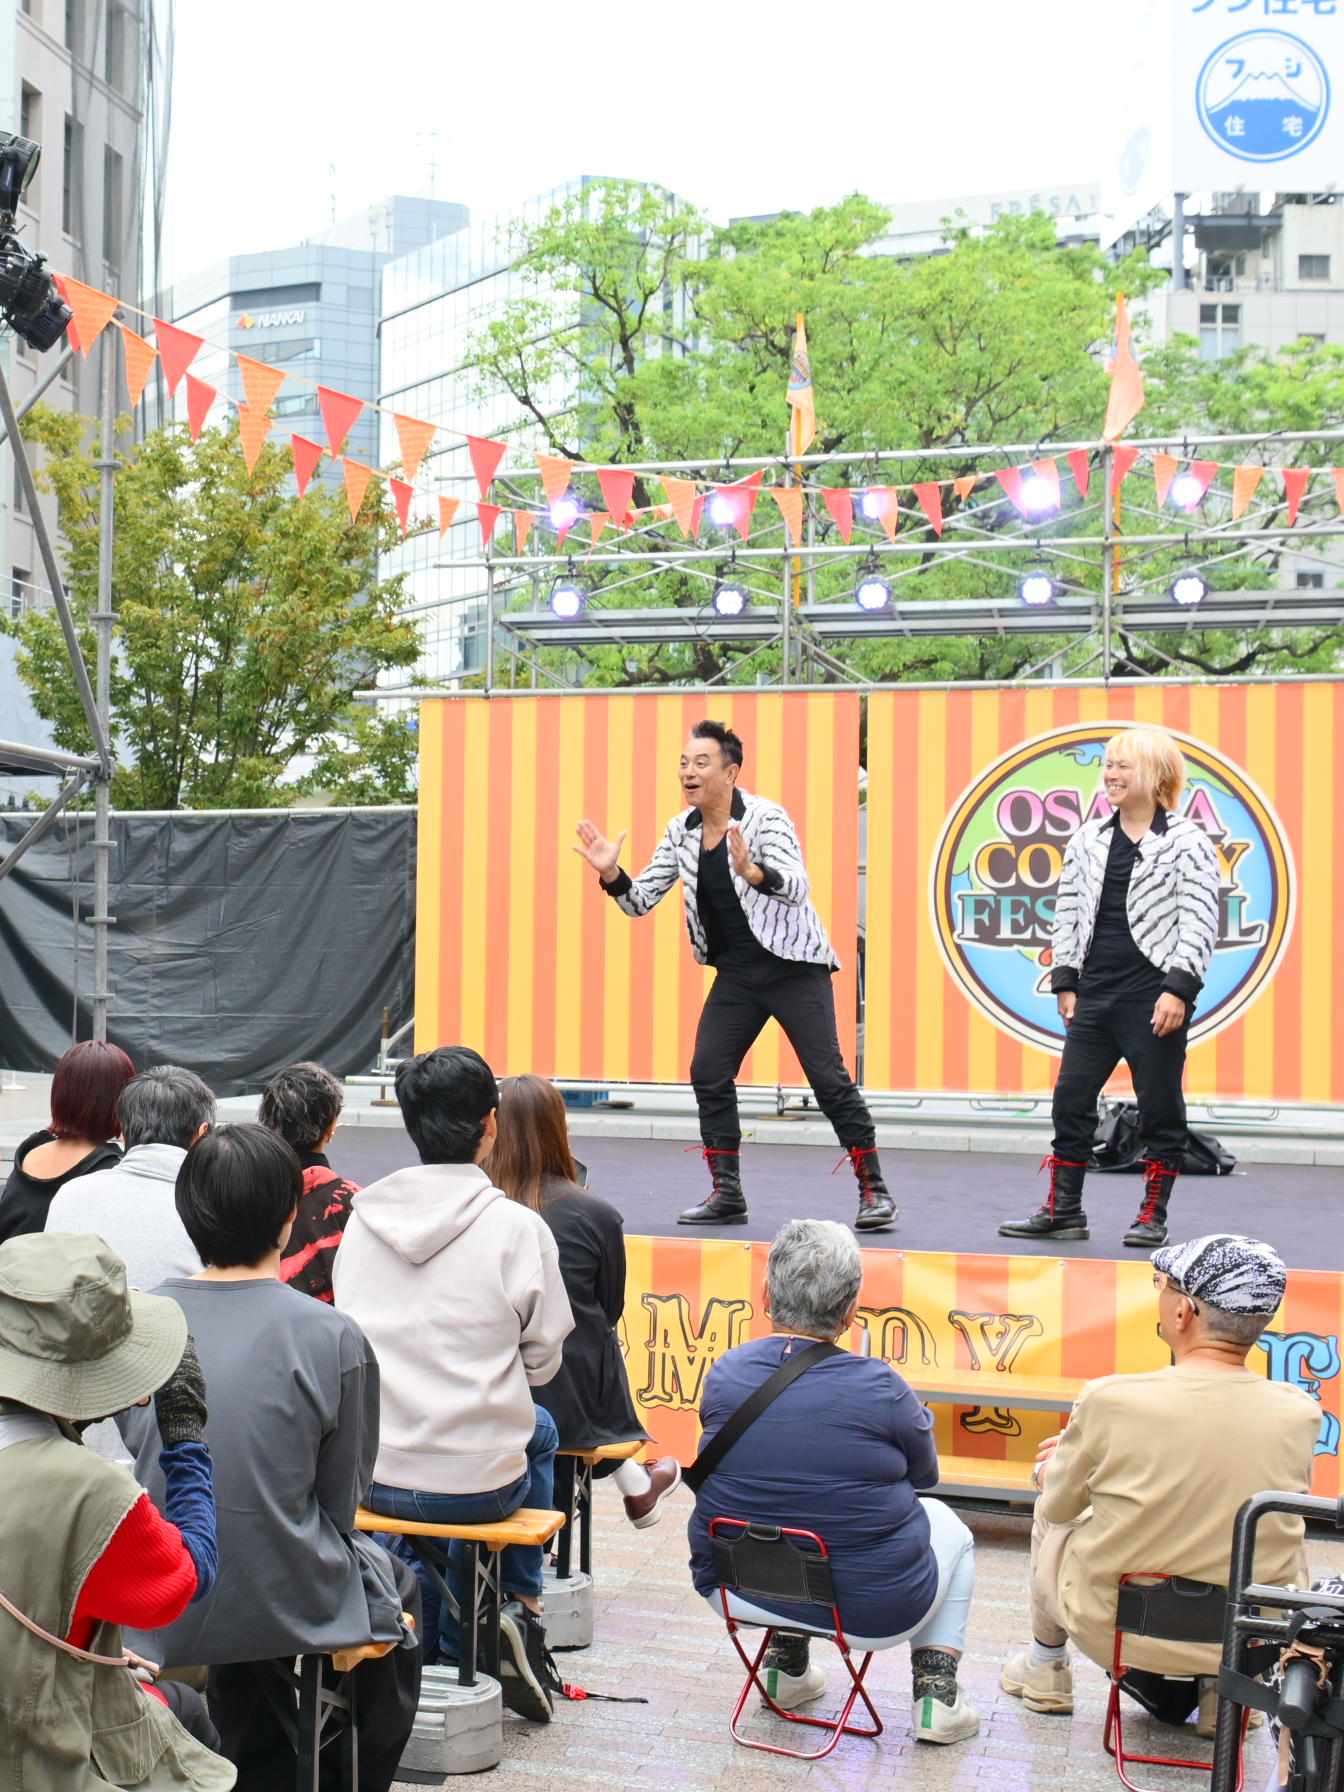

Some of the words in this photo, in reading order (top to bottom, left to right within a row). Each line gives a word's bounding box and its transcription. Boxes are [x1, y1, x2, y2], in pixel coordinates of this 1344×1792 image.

[256, 310, 305, 328] NANKAI
[997, 786, 1228, 837] OSAA
[974, 840, 1250, 890] COY
[958, 894, 1265, 943] FESL
